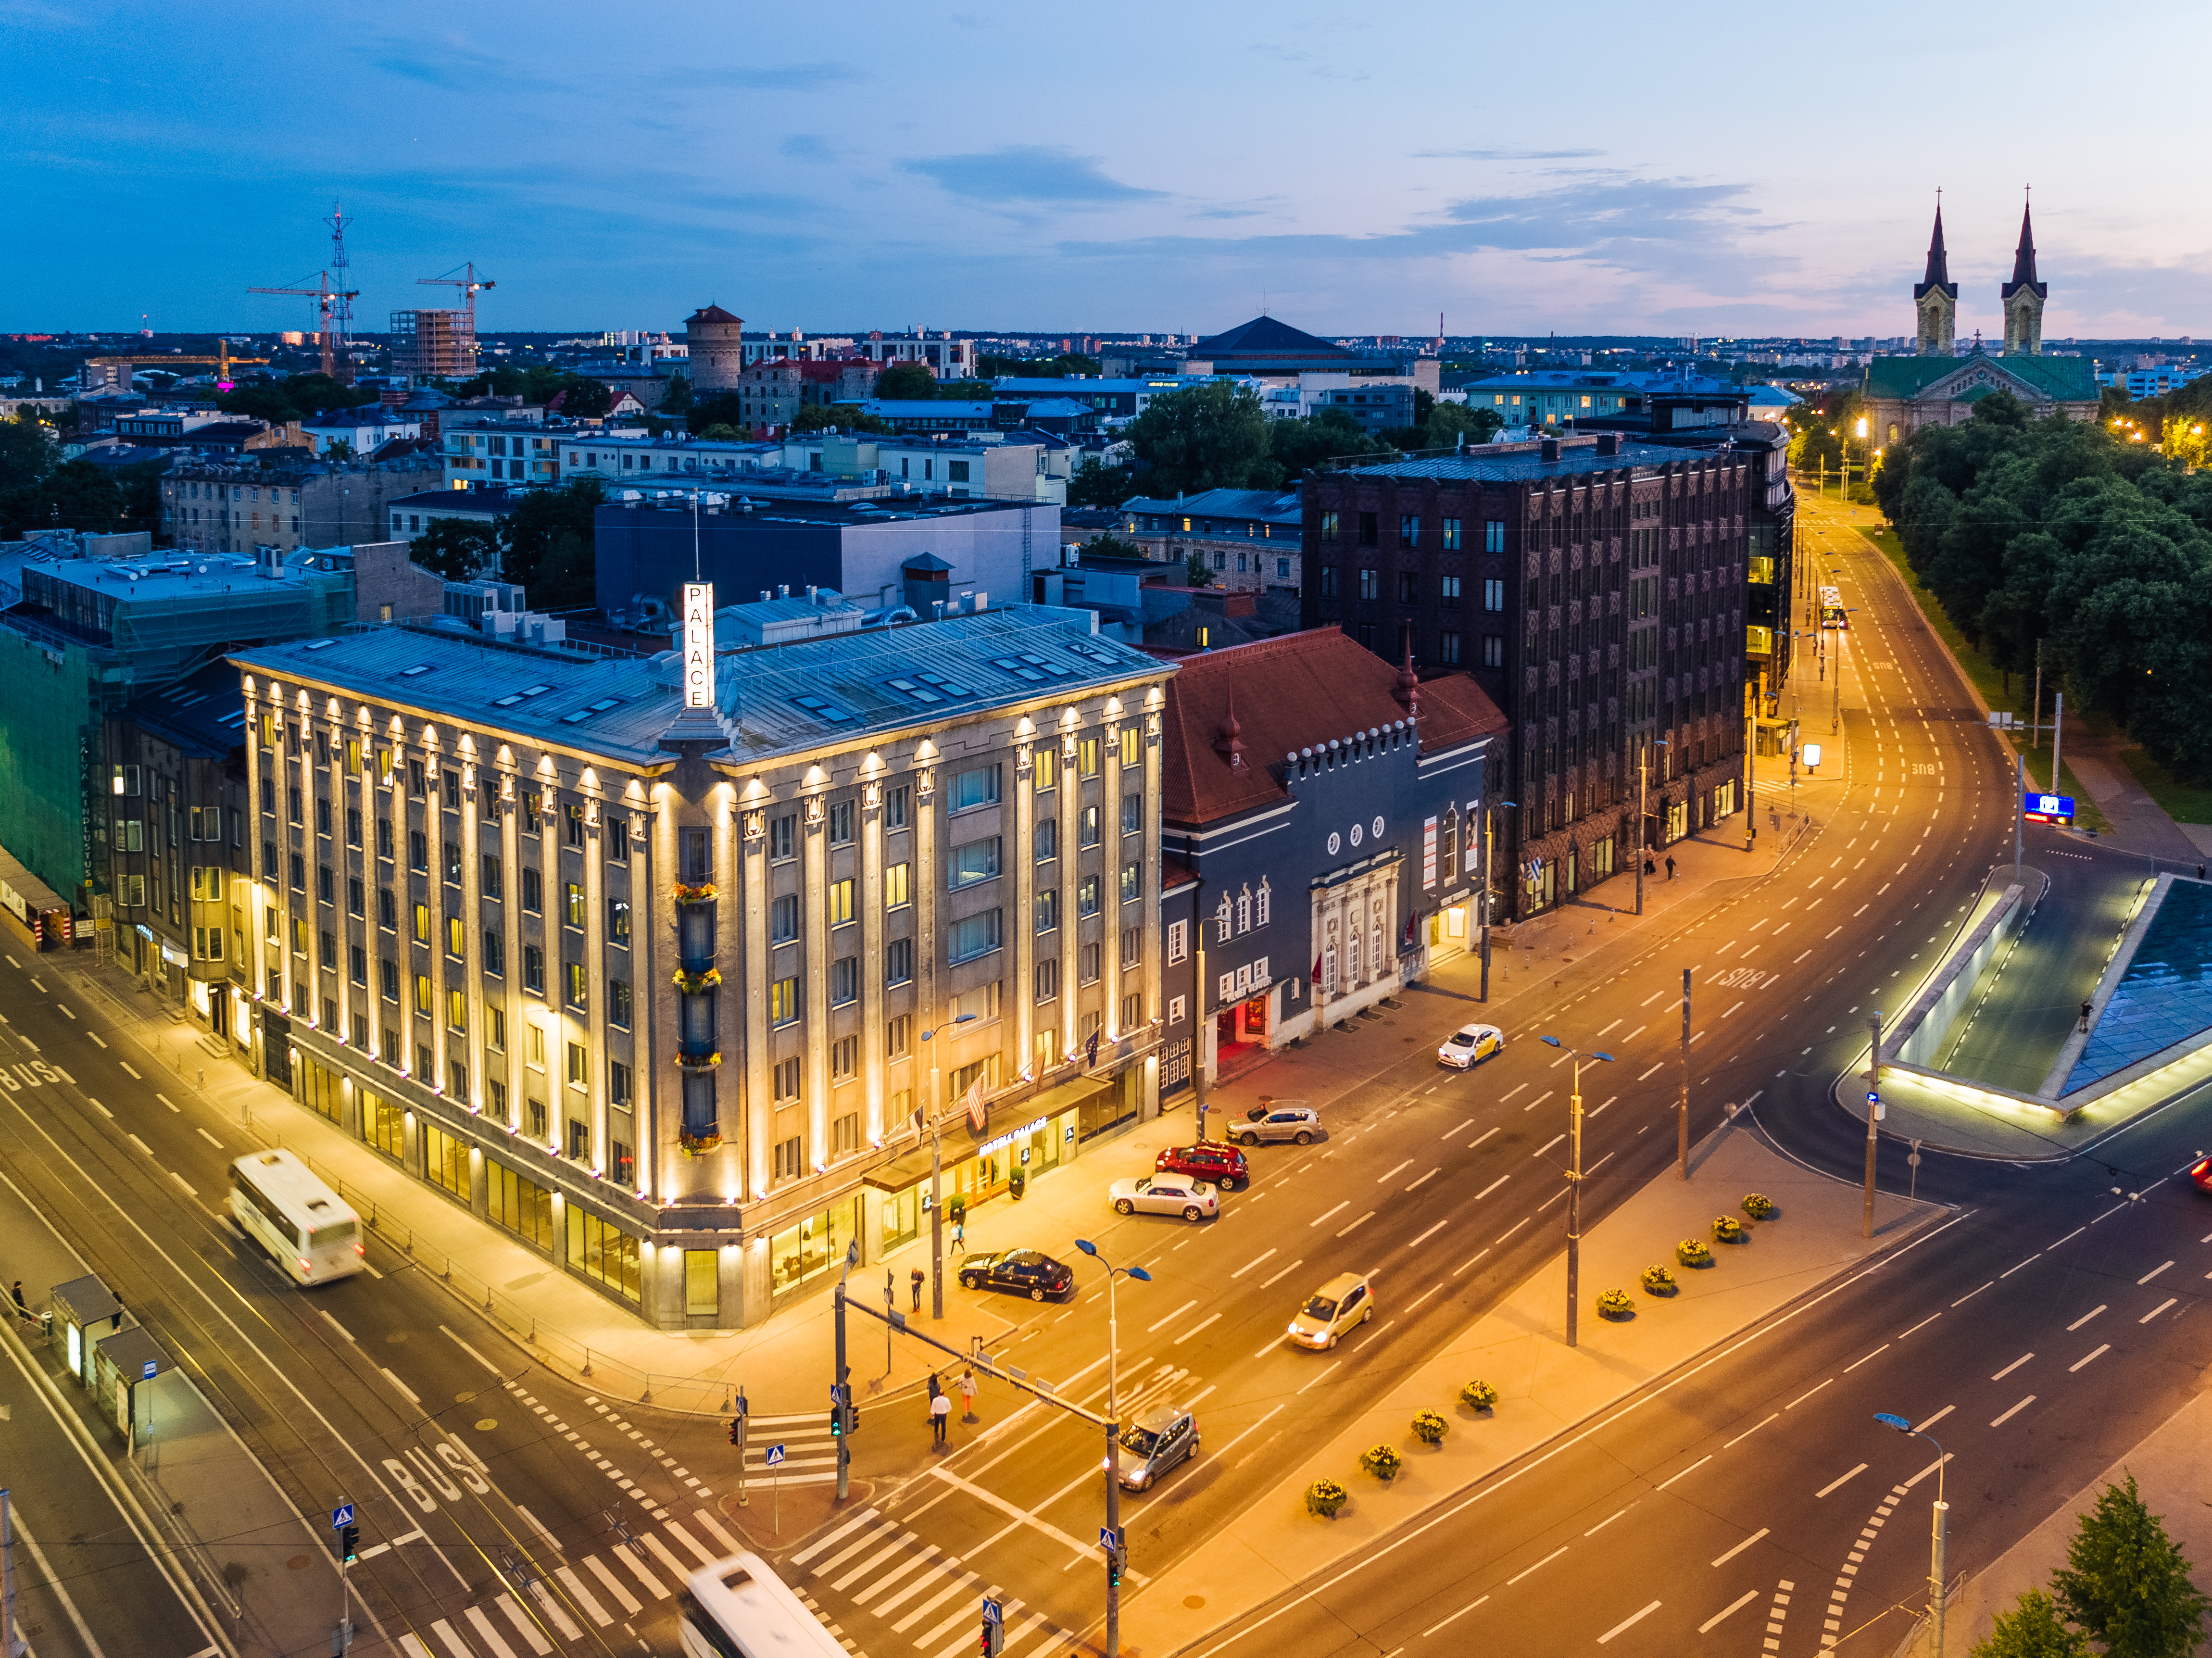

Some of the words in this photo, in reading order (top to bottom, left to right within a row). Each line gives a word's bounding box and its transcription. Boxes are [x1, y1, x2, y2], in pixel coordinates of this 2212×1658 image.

[690, 588, 703, 706] PALACE
[80, 737, 88, 780] SALVA
[1911, 763, 1935, 775] BUS
[82, 791, 92, 877] KINDLUSTUS
[1717, 967, 1769, 990] BUS
[0, 1060, 61, 1091] BUS
[978, 1132, 1013, 1157] HOTELL
[1104, 1364, 1203, 1422] BUS
[382, 1443, 490, 1513] BUS
